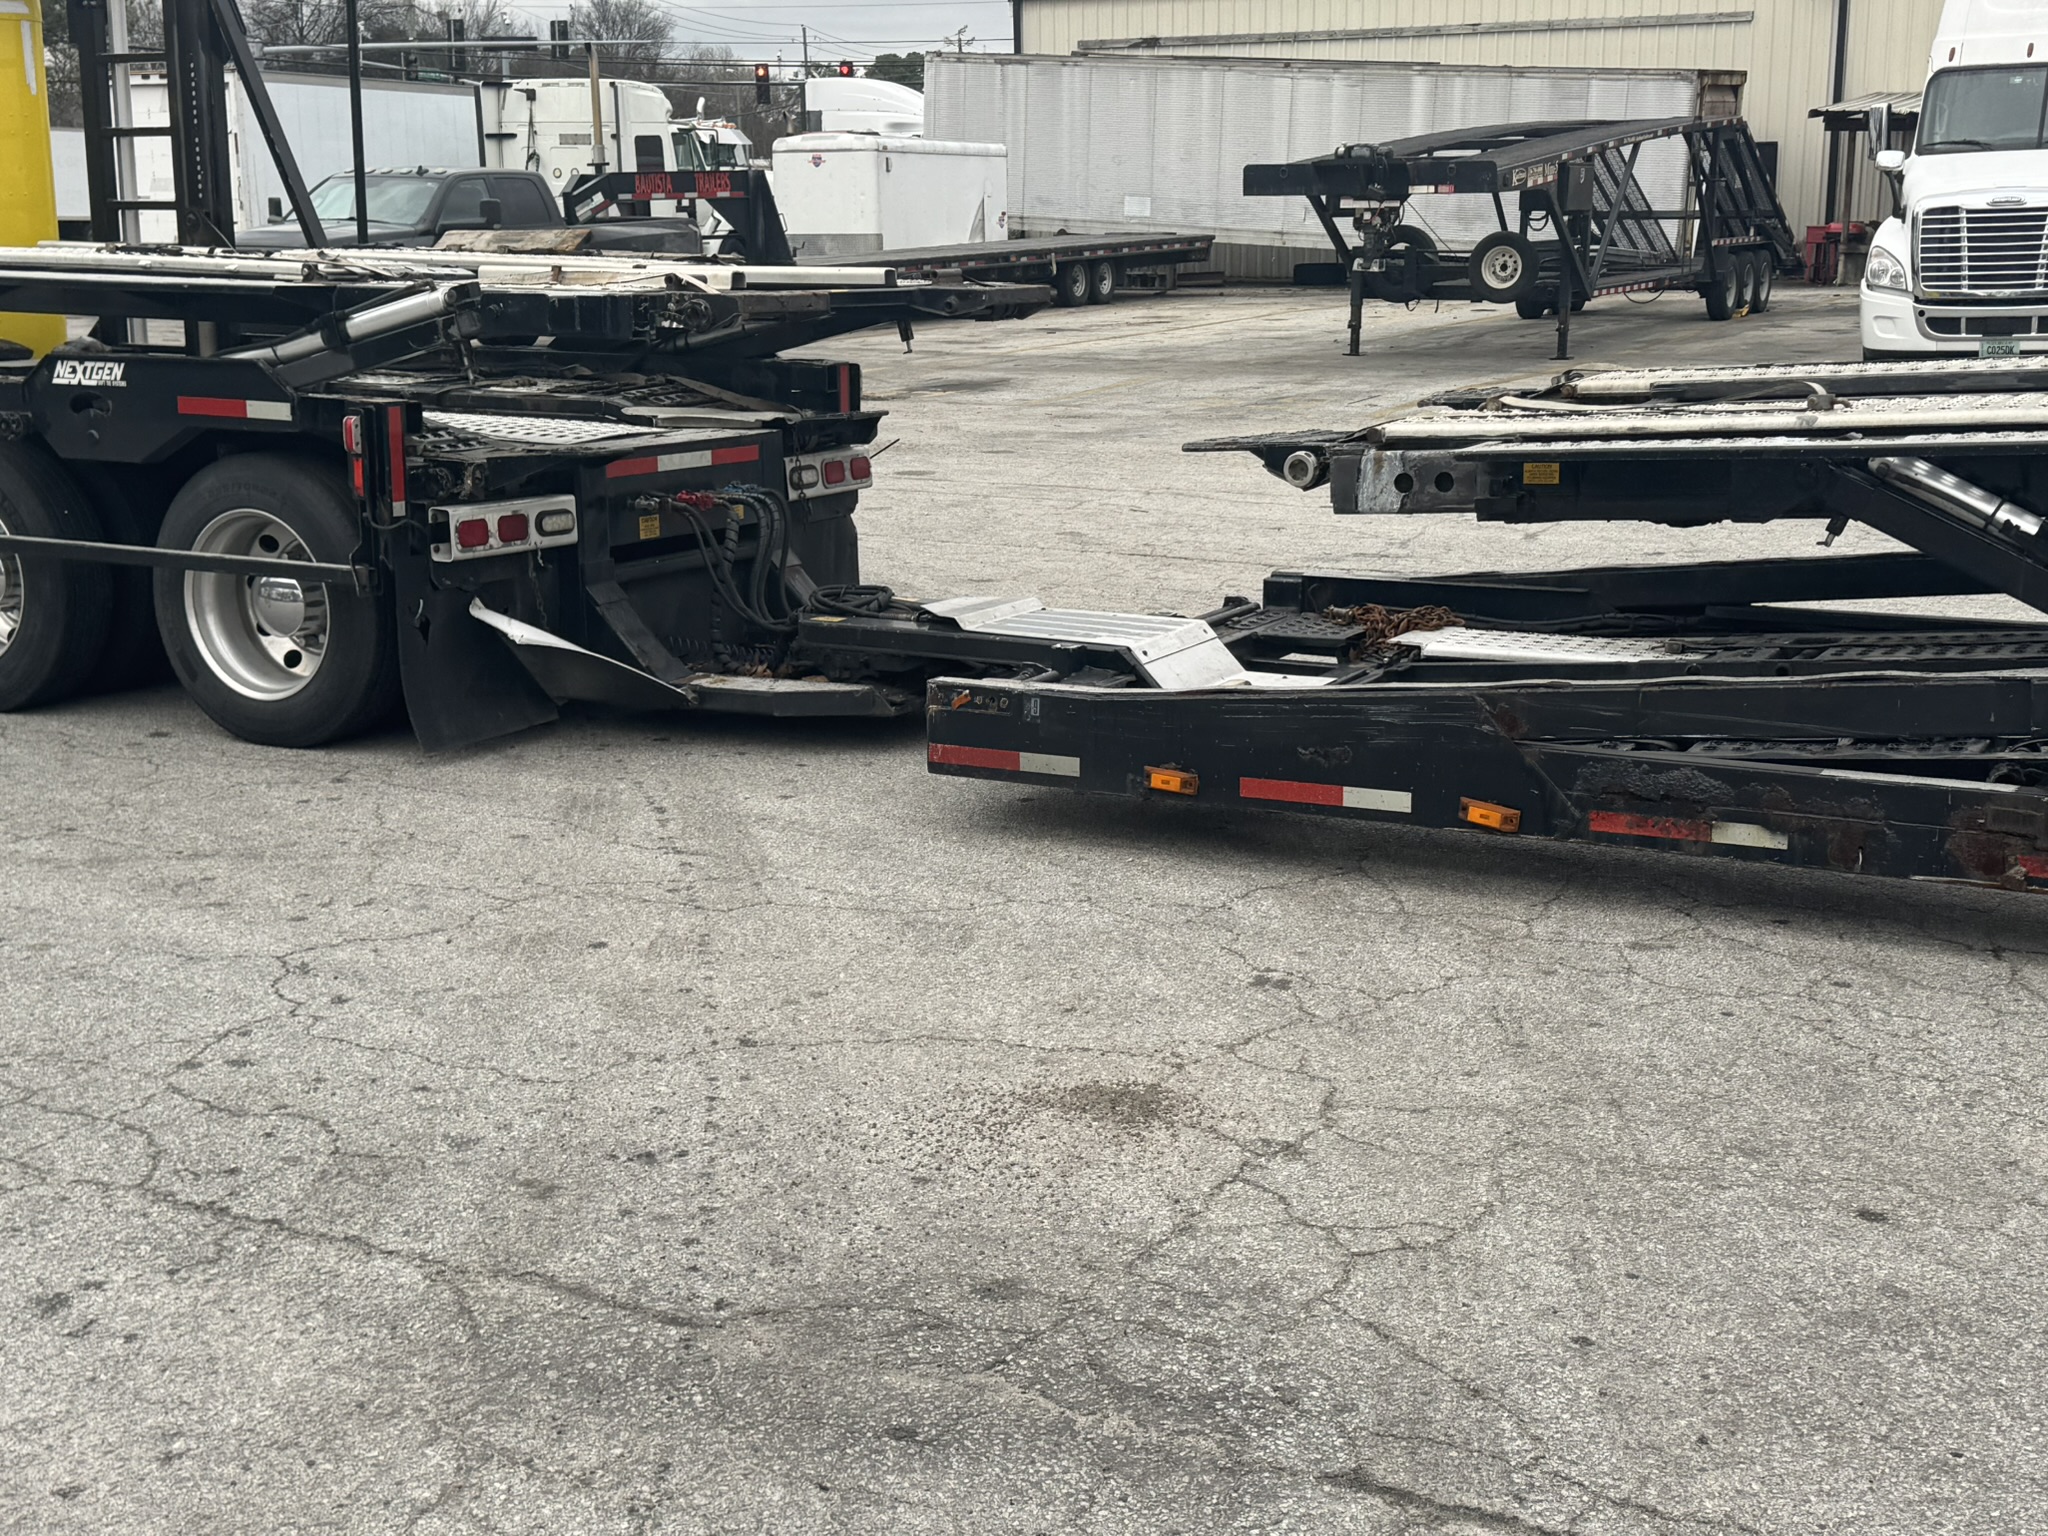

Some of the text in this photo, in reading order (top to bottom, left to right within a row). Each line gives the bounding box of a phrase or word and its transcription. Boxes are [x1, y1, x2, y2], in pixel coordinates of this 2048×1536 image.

[635, 172, 731, 194] BAUTISTA TRAILERS
[52, 360, 125, 385] NEXTGEN
